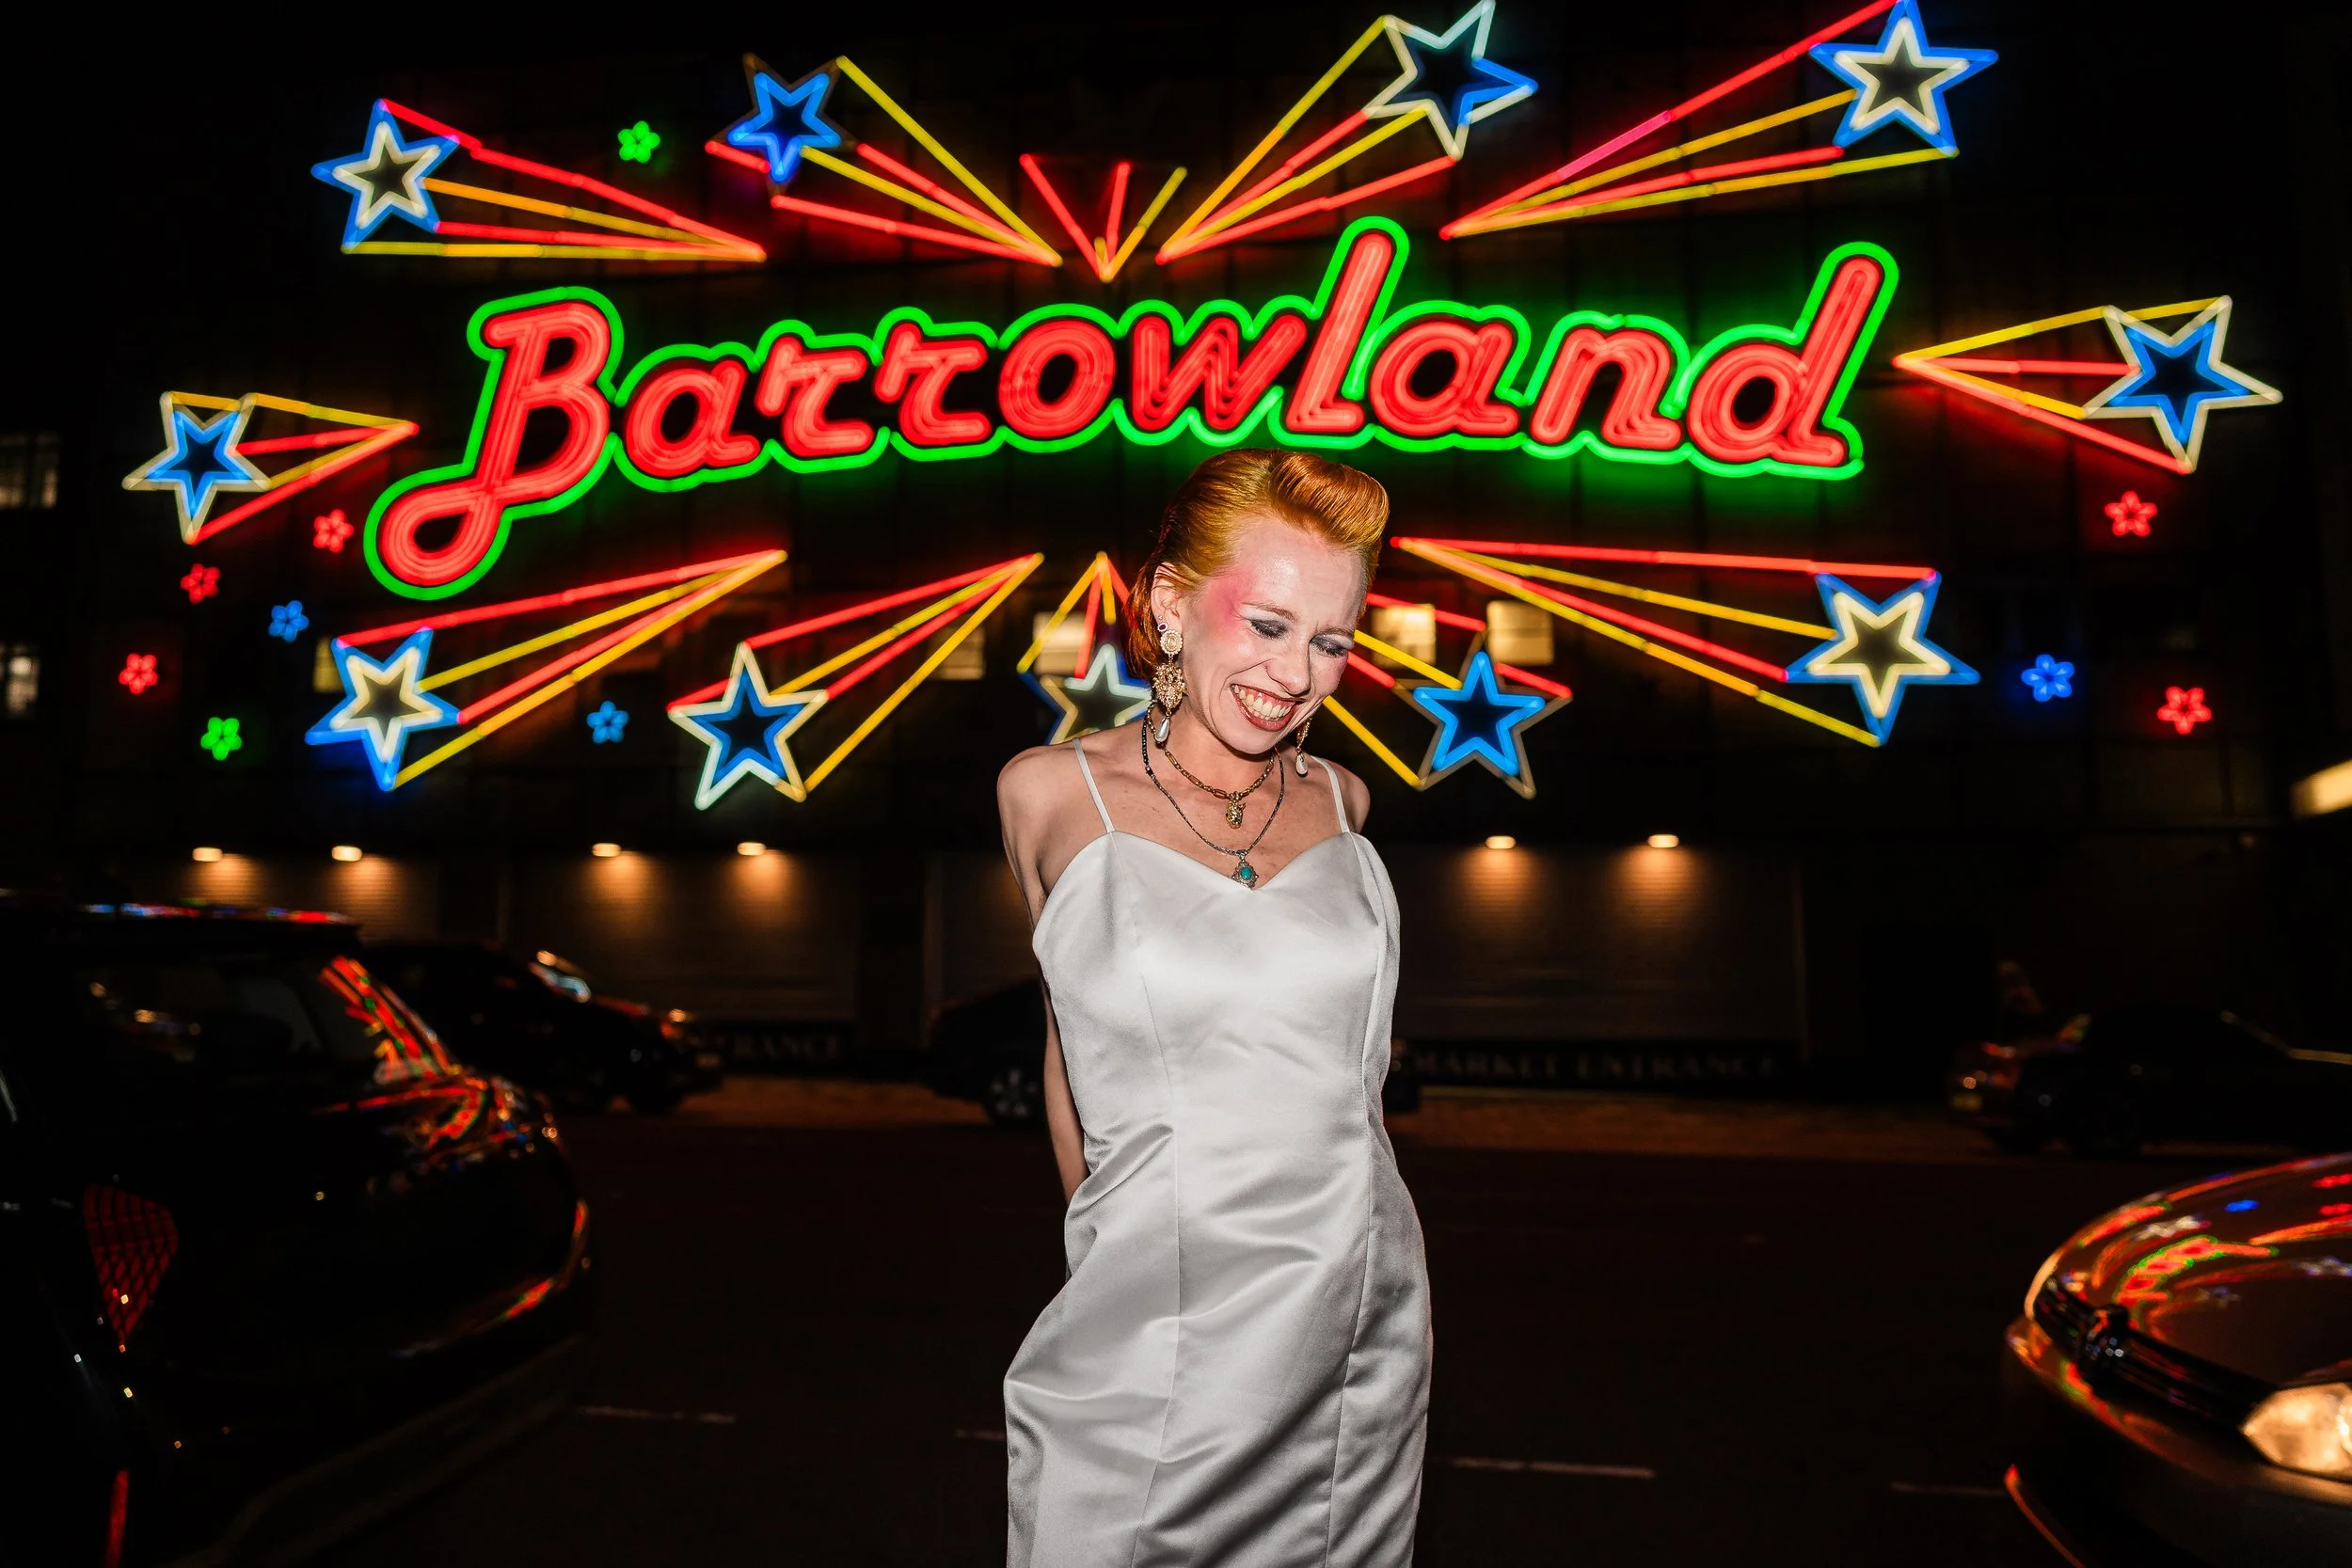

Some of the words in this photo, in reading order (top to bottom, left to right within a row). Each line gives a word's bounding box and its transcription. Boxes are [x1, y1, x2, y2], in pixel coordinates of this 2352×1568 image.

[374, 228, 1884, 592] Barrowland
[1413, 1051, 1558, 1079] MARKET
[1577, 1052, 1774, 1080] ENTRANCE
